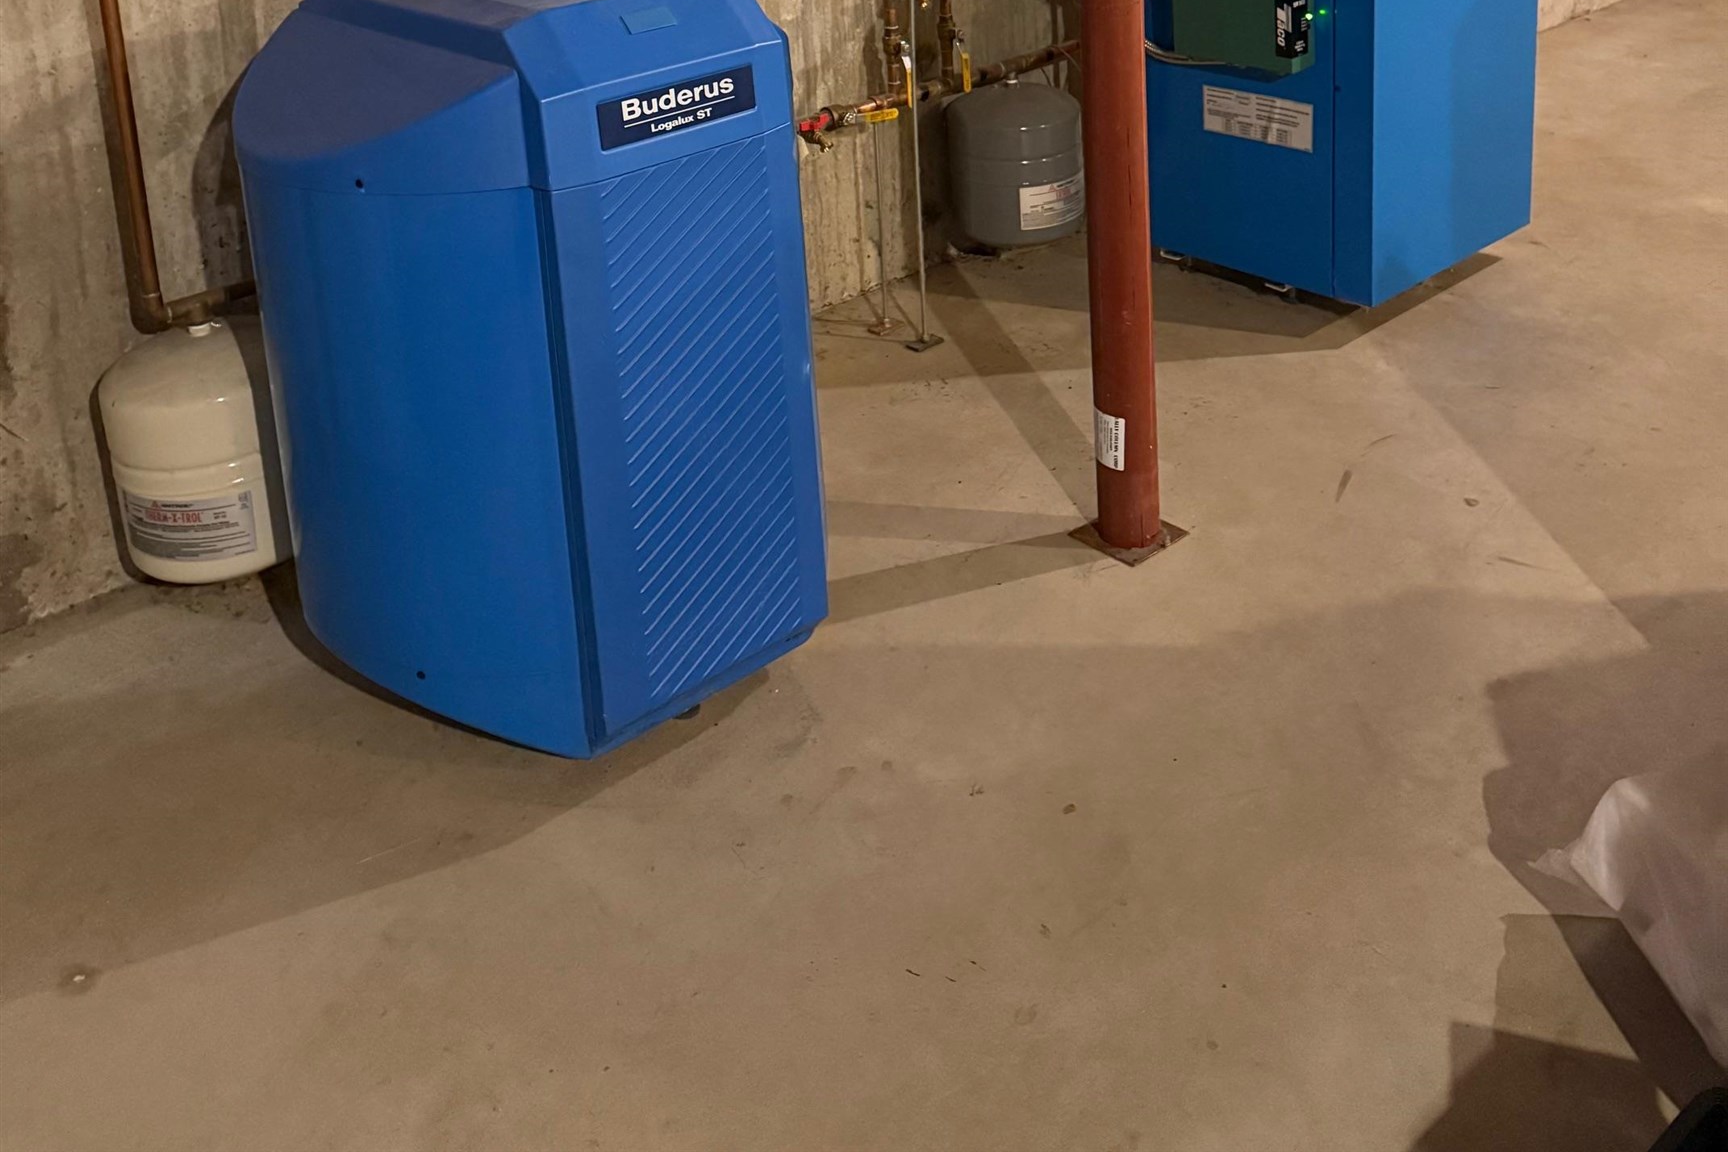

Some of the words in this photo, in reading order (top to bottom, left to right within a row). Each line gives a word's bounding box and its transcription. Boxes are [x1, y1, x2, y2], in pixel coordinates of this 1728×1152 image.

[1276, 3, 1292, 47] Taco
[621, 78, 734, 121] Buderus
[651, 115, 694, 132] Logalux
[697, 108, 713, 120] ST
